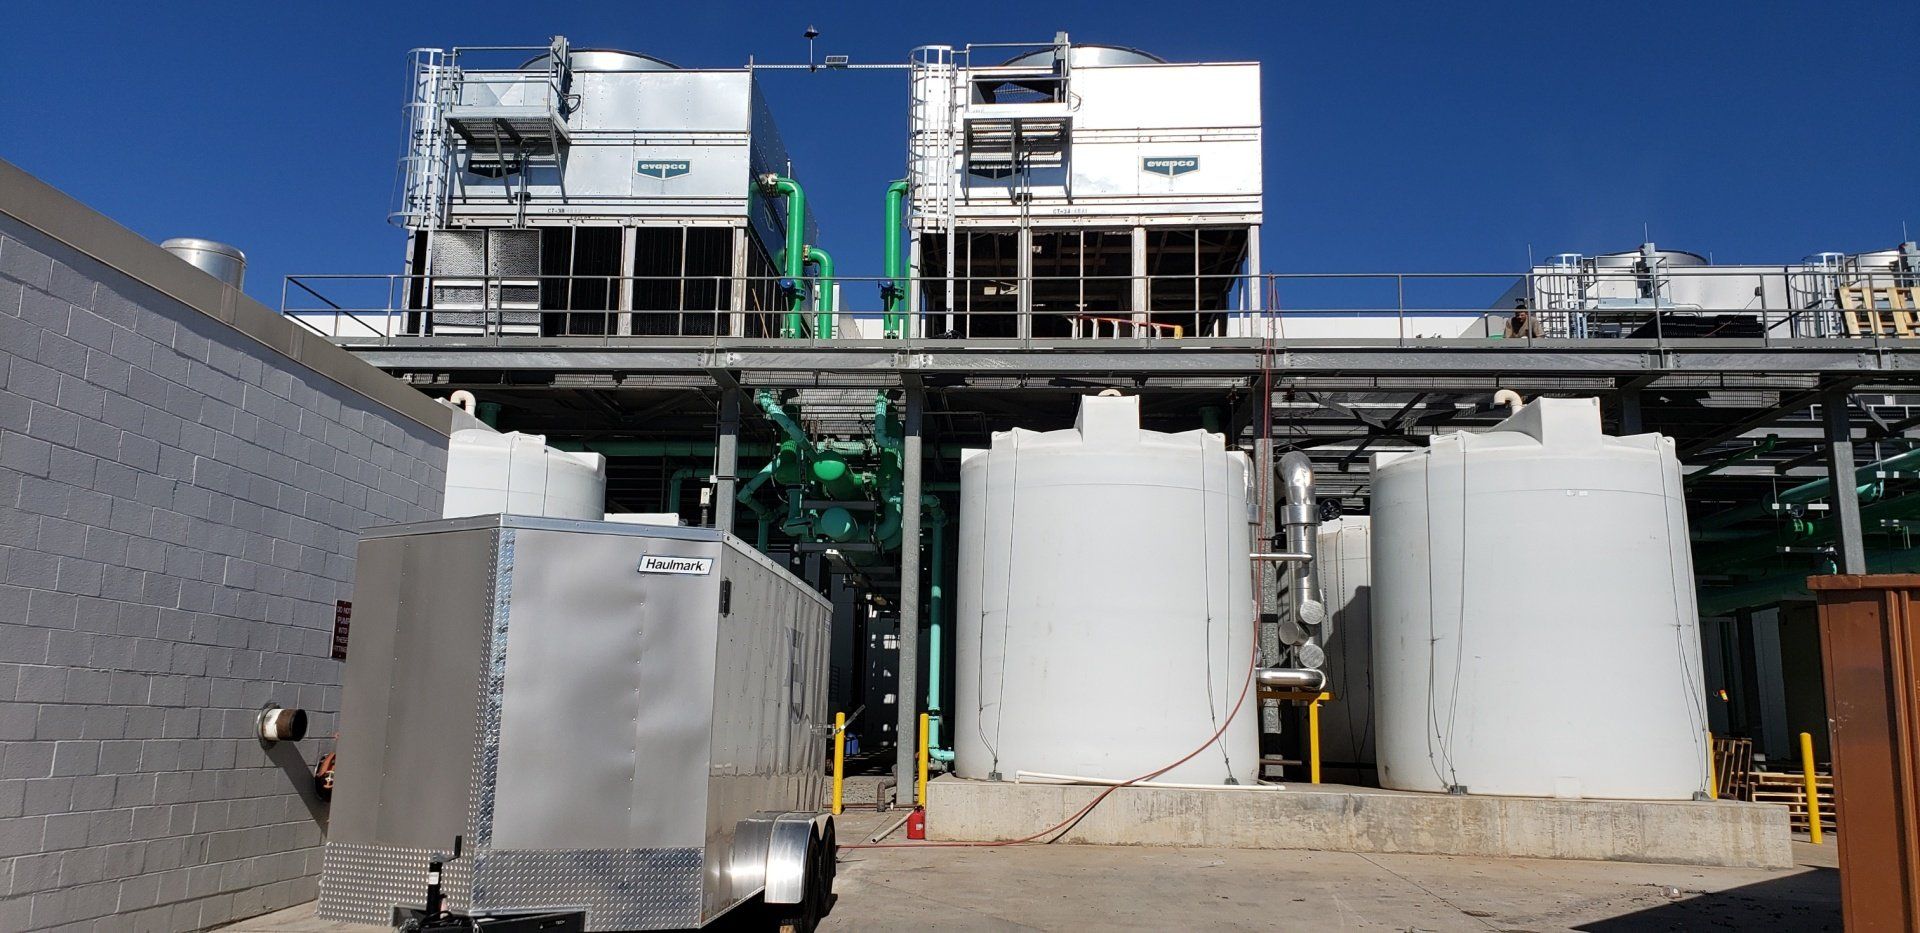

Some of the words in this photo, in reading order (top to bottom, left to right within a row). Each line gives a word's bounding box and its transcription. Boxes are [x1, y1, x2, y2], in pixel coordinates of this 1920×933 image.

[640, 163, 687, 176] evapco
[1146, 160, 1195, 174] evapco
[646, 558, 702, 571] Haulmark
